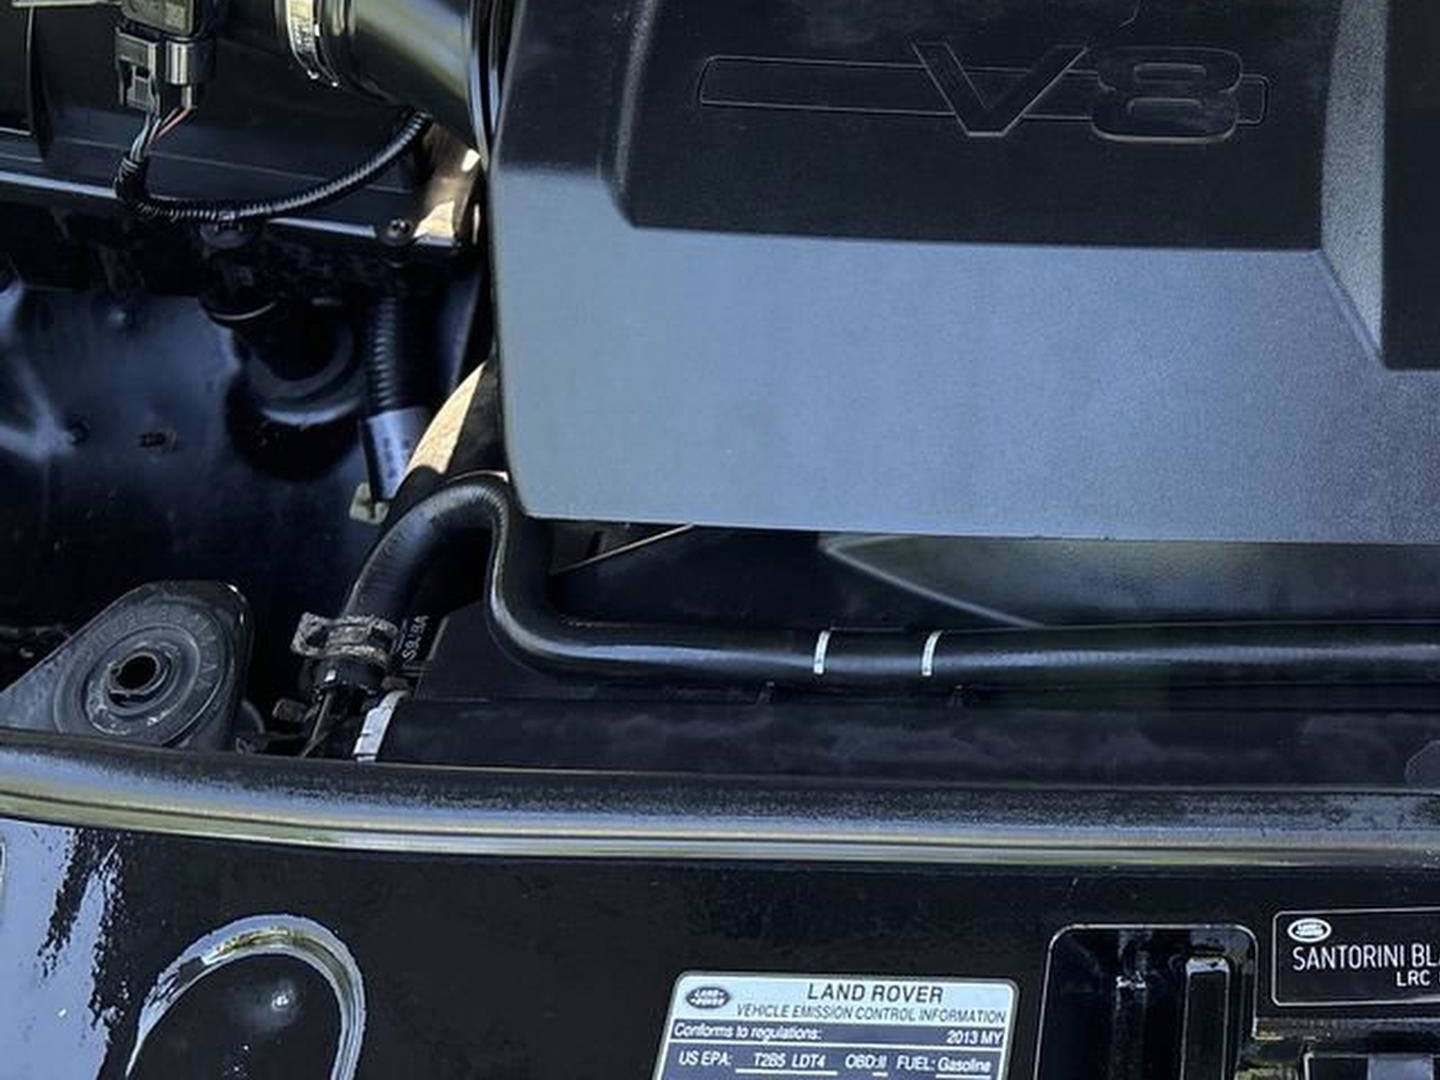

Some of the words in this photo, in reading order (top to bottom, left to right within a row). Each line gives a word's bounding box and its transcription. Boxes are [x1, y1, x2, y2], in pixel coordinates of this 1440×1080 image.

[908, 38, 1242, 143] V8
[1293, 943, 1404, 971] SANTORINI
[1396, 969, 1430, 987] LRC
[807, 983, 865, 1001] LAND
[871, 984, 943, 1003] ROVER
[737, 1003, 790, 1018] VEHICLE
[792, 1004, 851, 1020] EMISSION
[855, 1006, 915, 1021] CONTROL
[919, 1007, 1006, 1023] INFORMATION
[674, 1022, 733, 1038] Conforms
[736, 1024, 748, 1038] to
[750, 1024, 822, 1042] regulations:
[946, 1029, 979, 1044] 2013
[980, 1030, 1003, 1045] MY
[678, 1050, 700, 1065] US
[701, 1051, 732, 1066] EPA:
[791, 1053, 827, 1068] LDT4
[896, 1055, 936, 1070] FUEL:
[937, 1056, 992, 1072] Gasoline
